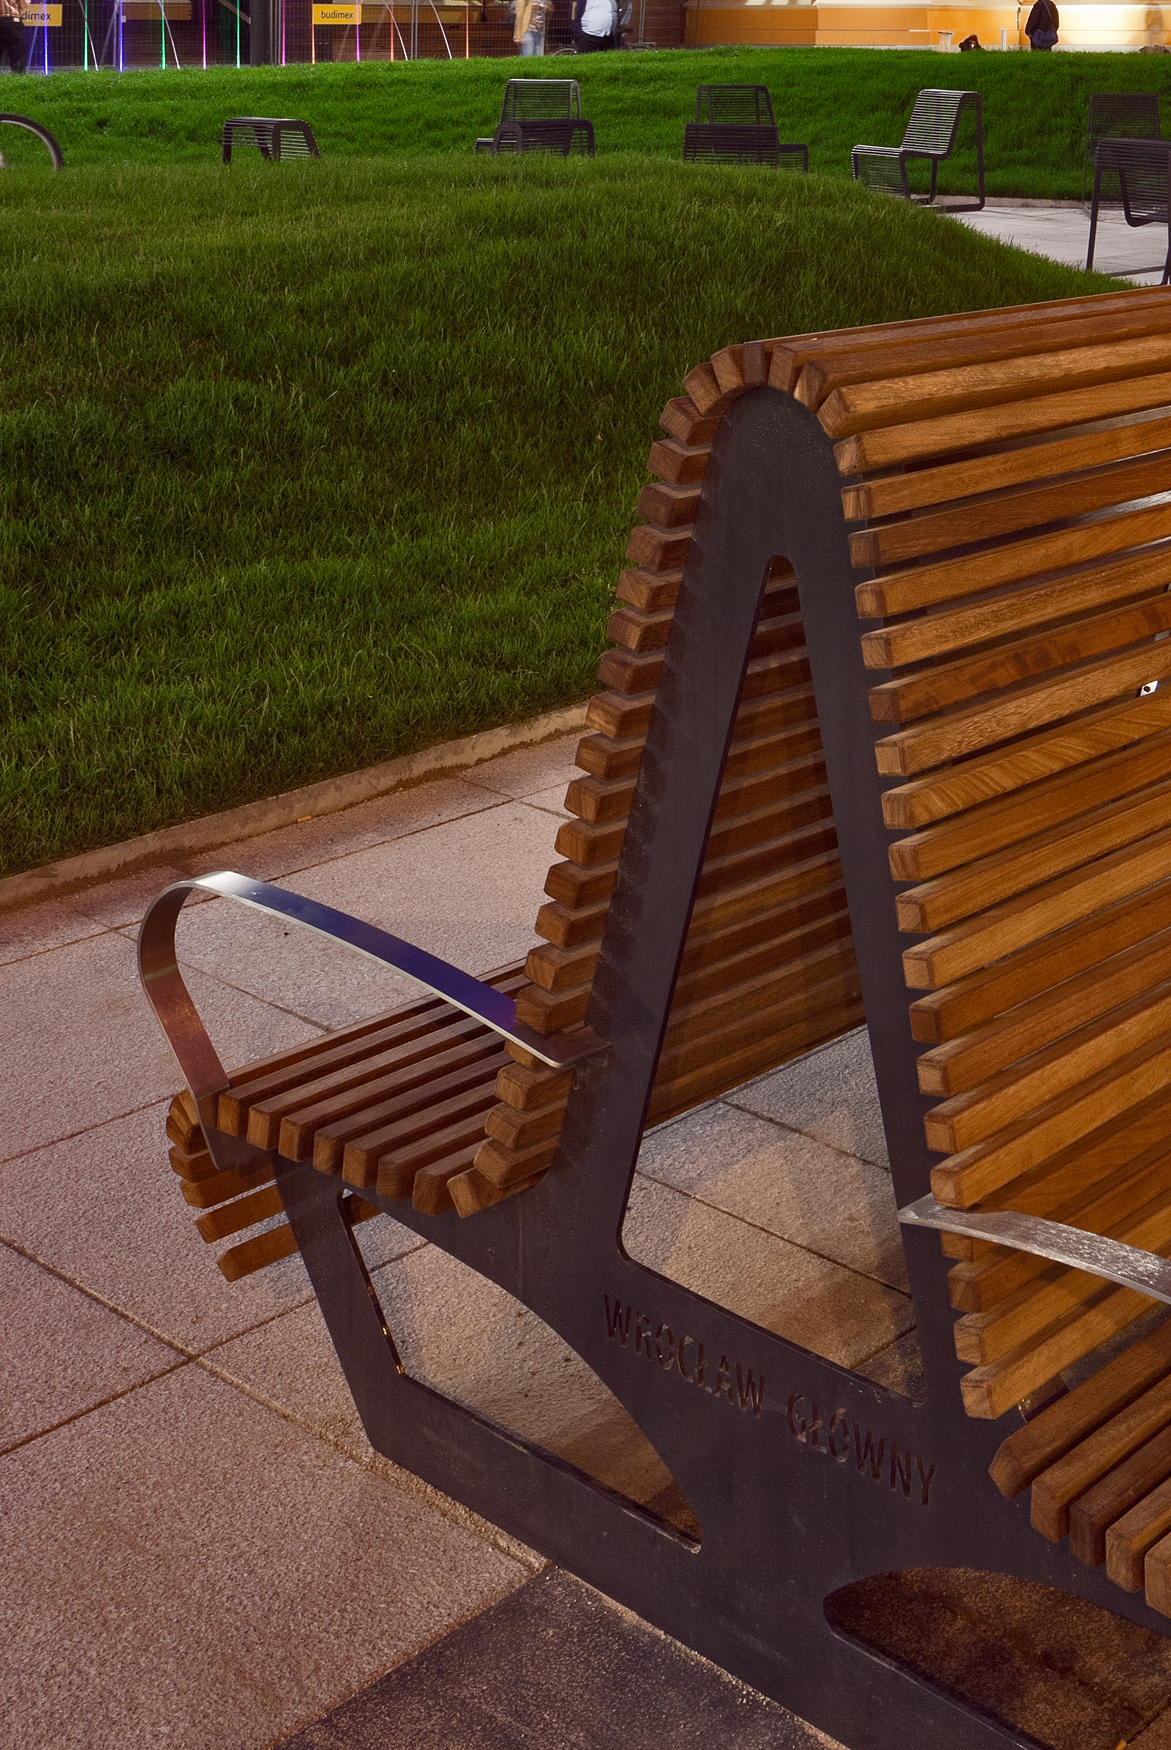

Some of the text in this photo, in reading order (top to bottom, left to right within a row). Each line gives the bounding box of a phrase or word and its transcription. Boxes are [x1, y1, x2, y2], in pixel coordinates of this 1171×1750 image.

[21, 11, 52, 21] dimex
[320, 9, 354, 19] budimex
[603, 1293, 936, 1506] WROCŁAW GŁÓWNY
